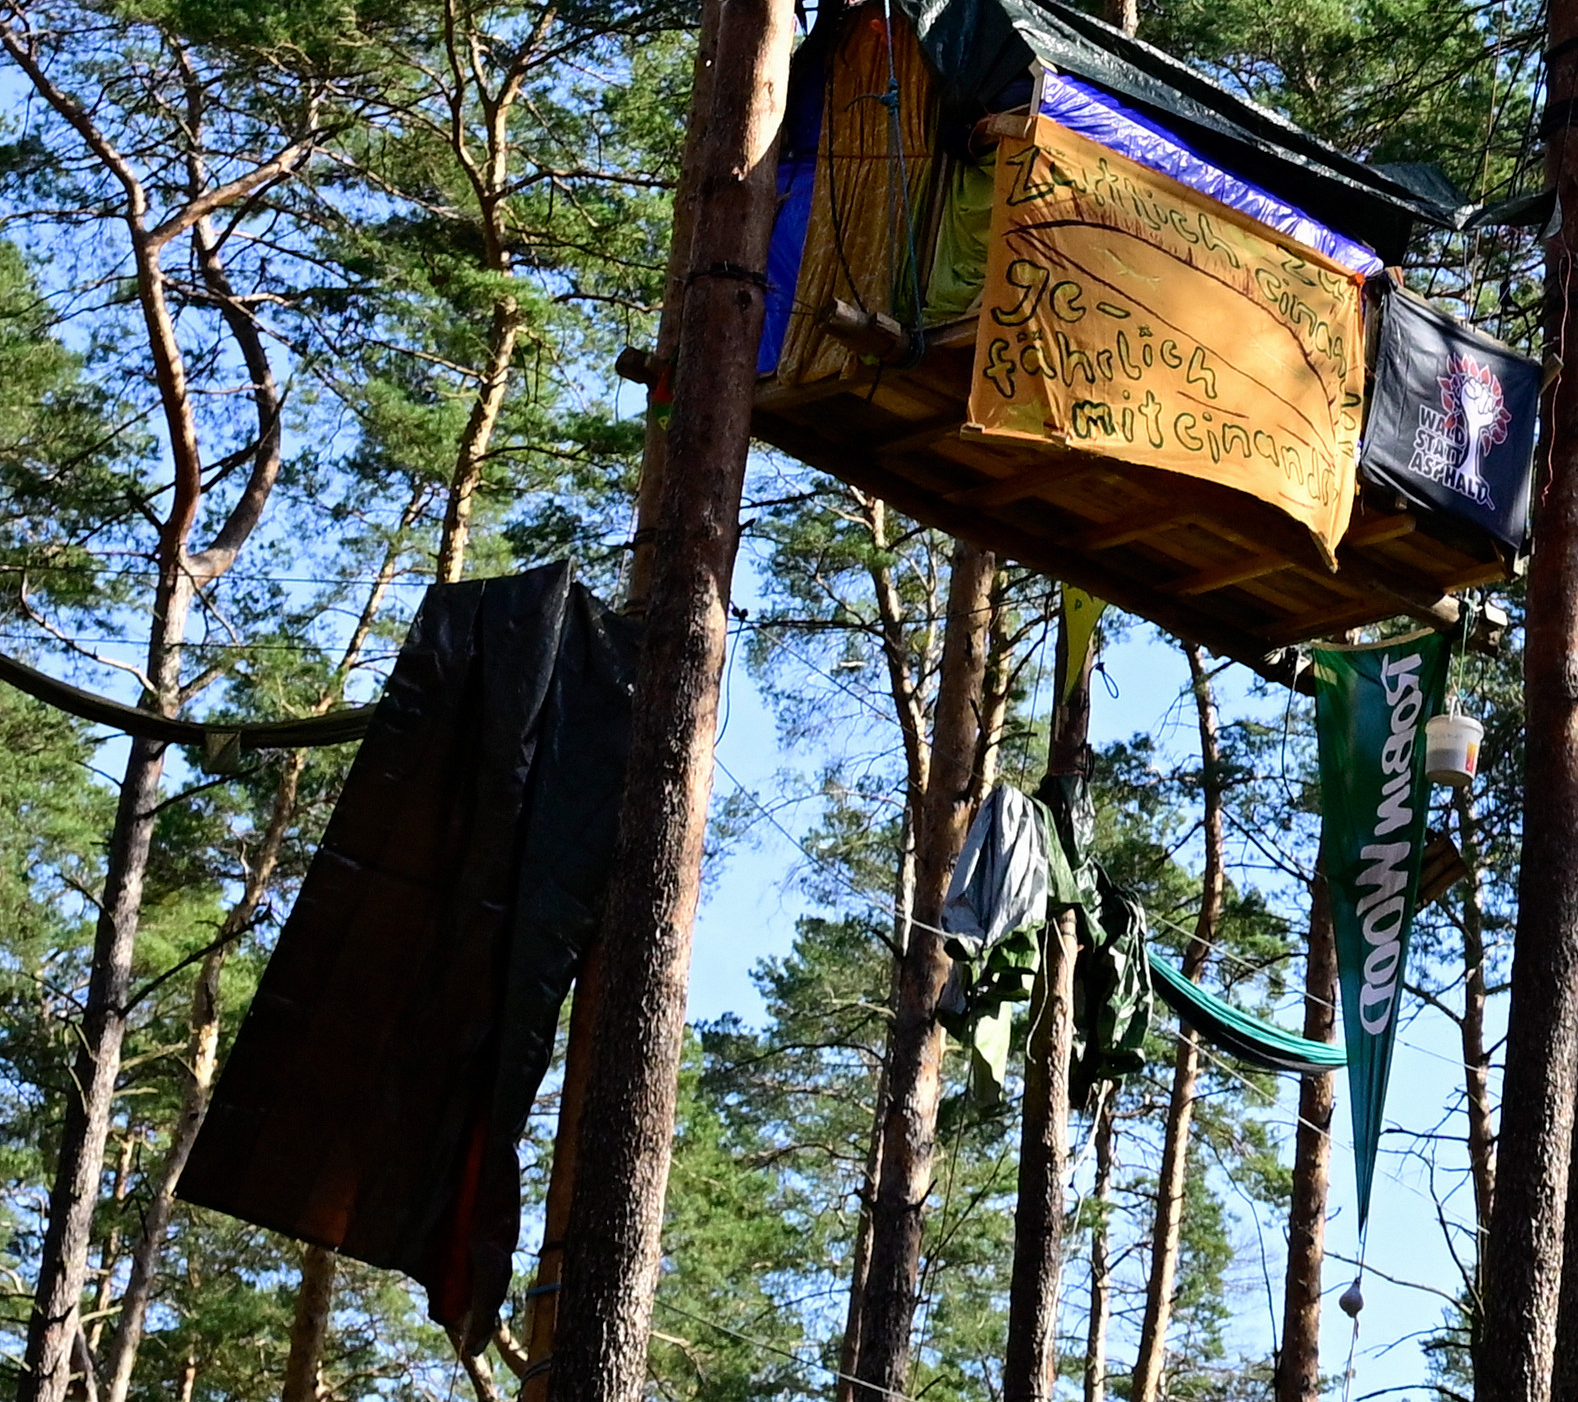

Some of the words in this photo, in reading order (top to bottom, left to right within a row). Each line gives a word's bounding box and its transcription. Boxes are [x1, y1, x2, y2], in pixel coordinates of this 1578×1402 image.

[984, 325, 1217, 399] fährlich
[1414, 428, 1465, 468] STATT
[1419, 404, 1466, 447] WALD
[1410, 450, 1488, 504] ASPHALT
